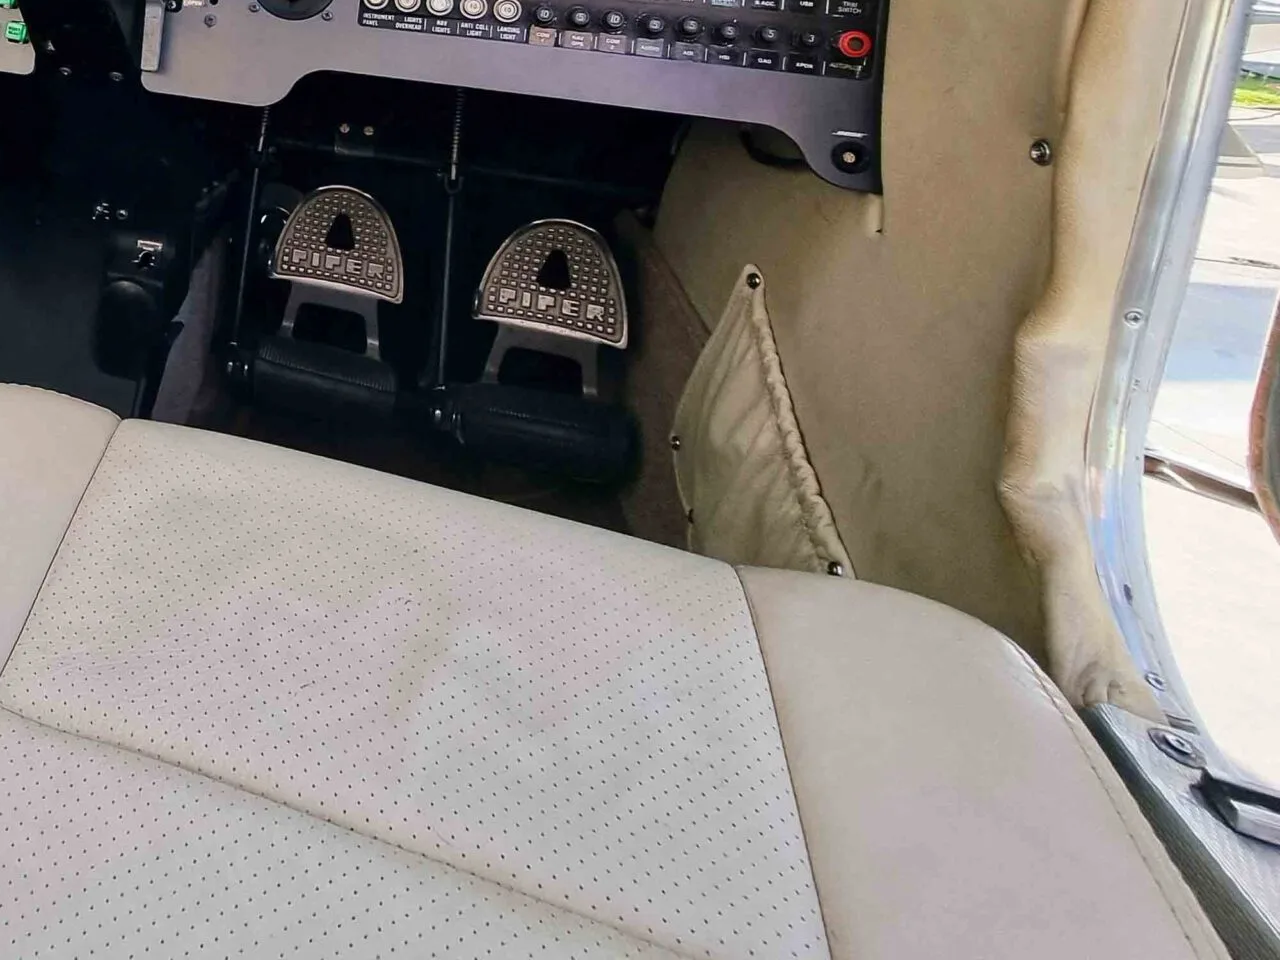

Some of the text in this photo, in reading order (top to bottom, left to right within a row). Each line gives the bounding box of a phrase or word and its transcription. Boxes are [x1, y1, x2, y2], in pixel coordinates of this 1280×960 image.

[363, 13, 395, 21] INSTRUMENT
[404, 16, 422, 24] LIGHTS
[363, 19, 378, 27] PANEL
[395, 22, 422, 30] OVERHEAD
[460, 22, 489, 31] ANTI COLL
[432, 26, 451, 34] LIGHTS
[466, 29, 482, 37] LIGHT
[497, 26, 520, 34] LANDING
[291, 248, 385, 280] PIPER
[499, 288, 606, 323] PIPER
